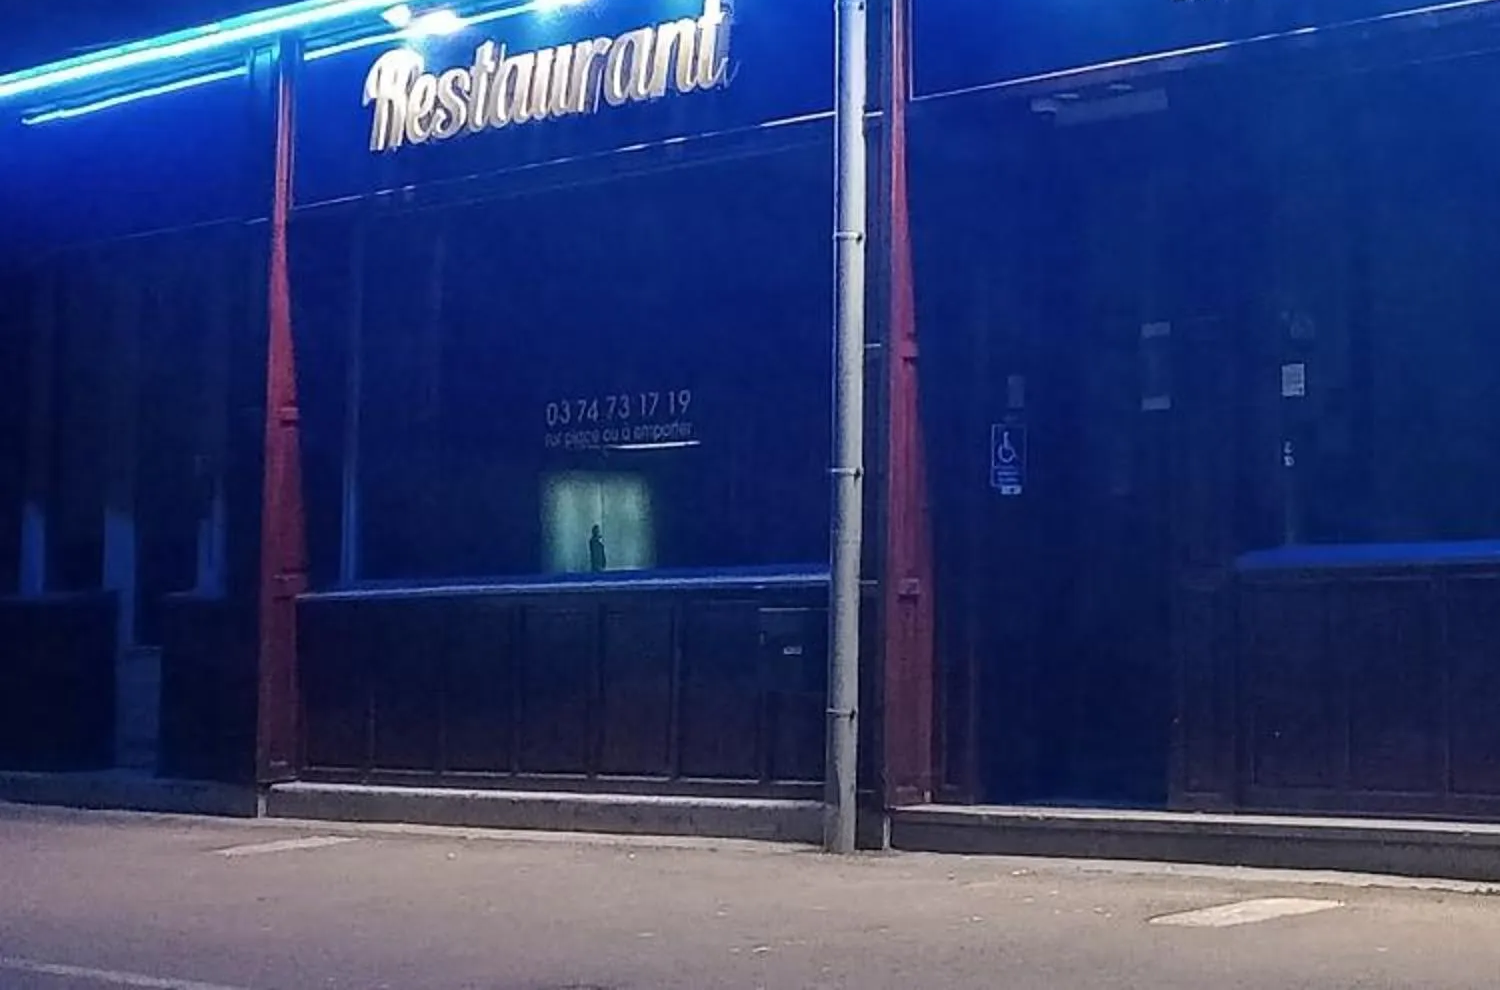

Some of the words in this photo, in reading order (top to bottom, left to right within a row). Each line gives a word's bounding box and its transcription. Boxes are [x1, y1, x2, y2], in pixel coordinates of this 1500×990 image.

[546, 400, 571, 426] 03
[577, 396, 599, 422] 74
[606, 394, 630, 419] 73
[640, 391, 659, 416] 17
[668, 389, 691, 414] 19
[603, 427, 619, 442] ou
[621, 421, 631, 441] à
